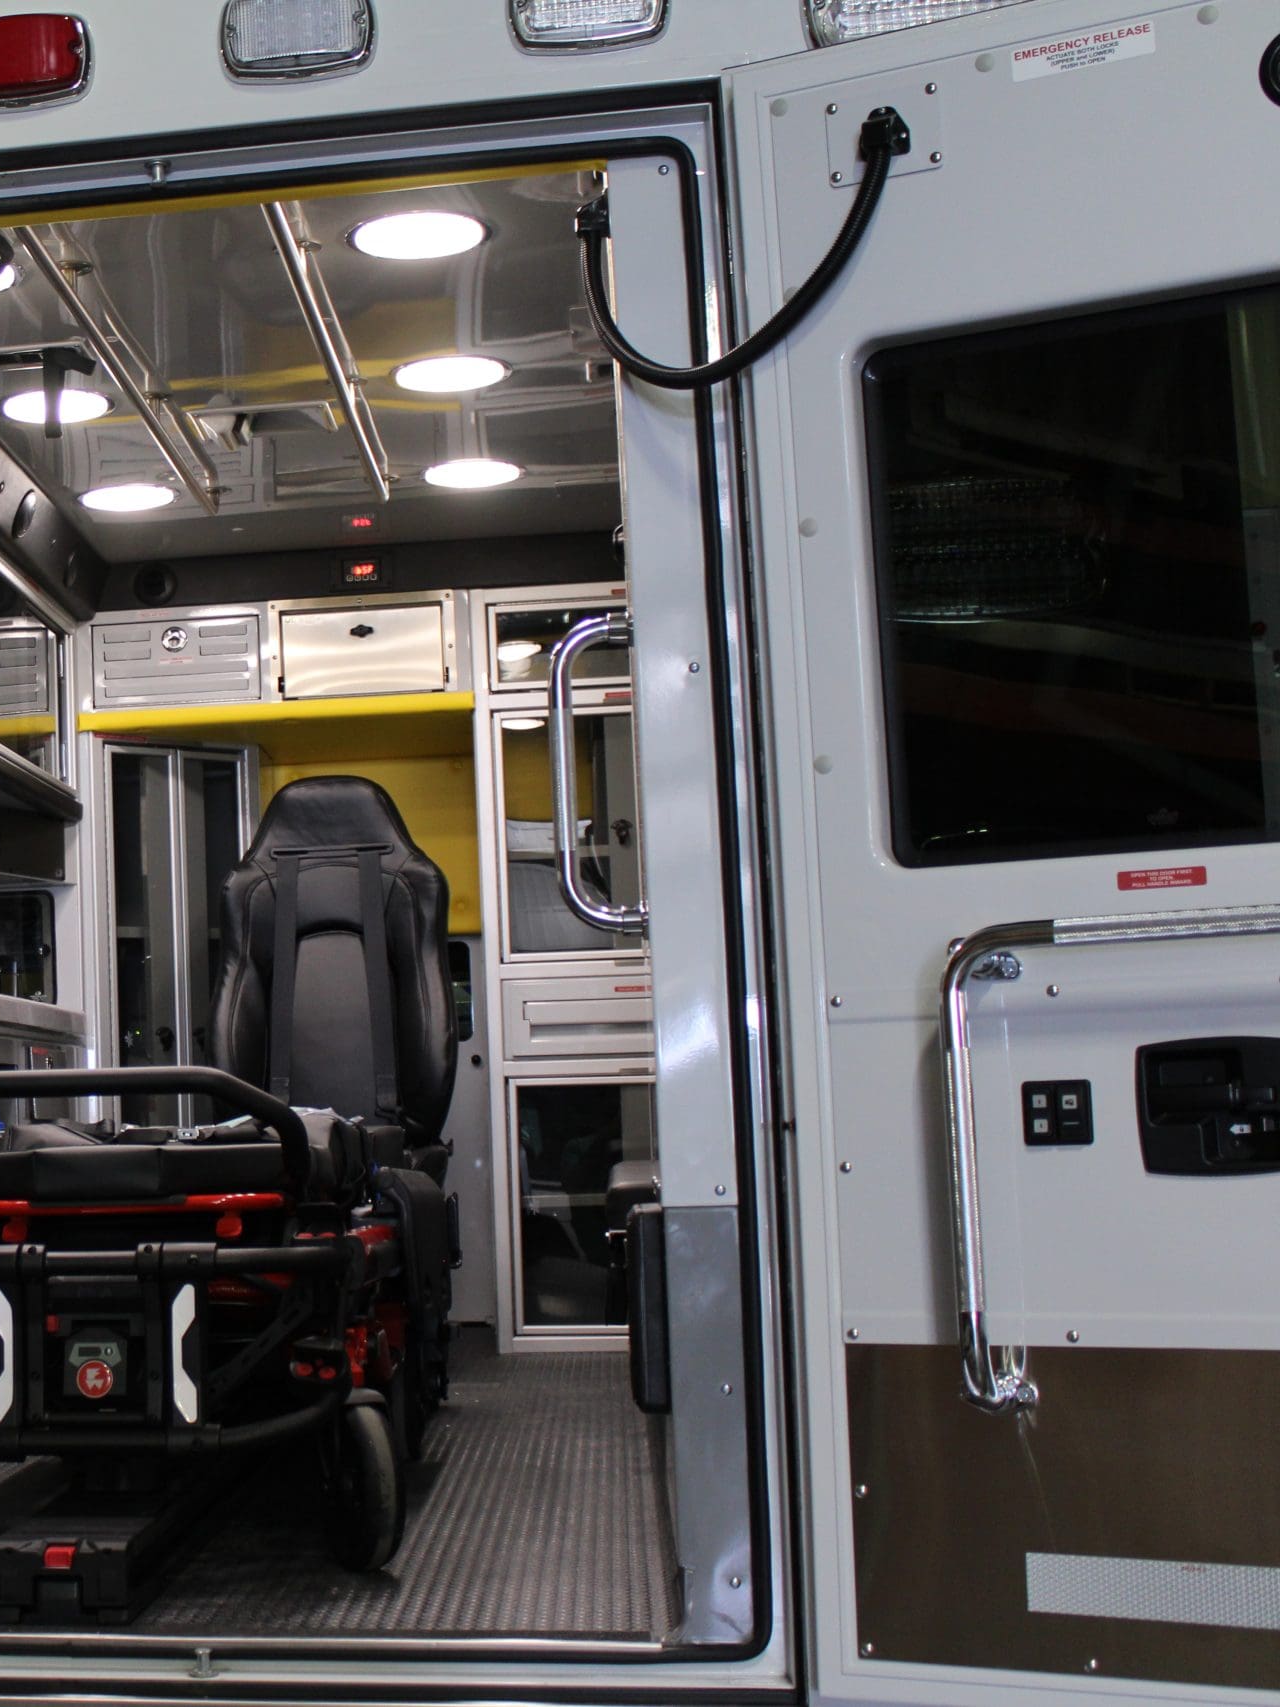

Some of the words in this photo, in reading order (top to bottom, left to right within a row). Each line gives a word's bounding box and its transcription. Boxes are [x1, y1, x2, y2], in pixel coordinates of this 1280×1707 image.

[1014, 37, 1090, 61] EMERGENCY
[1093, 23, 1151, 44] RELEASE
[1046, 50, 1076, 61] ACTUATE
[1077, 46, 1095, 55] BOTH
[1096, 41, 1119, 50] LOCKS
[1060, 62, 1078, 70] PUSH
[1087, 56, 1106, 65] OPEN
